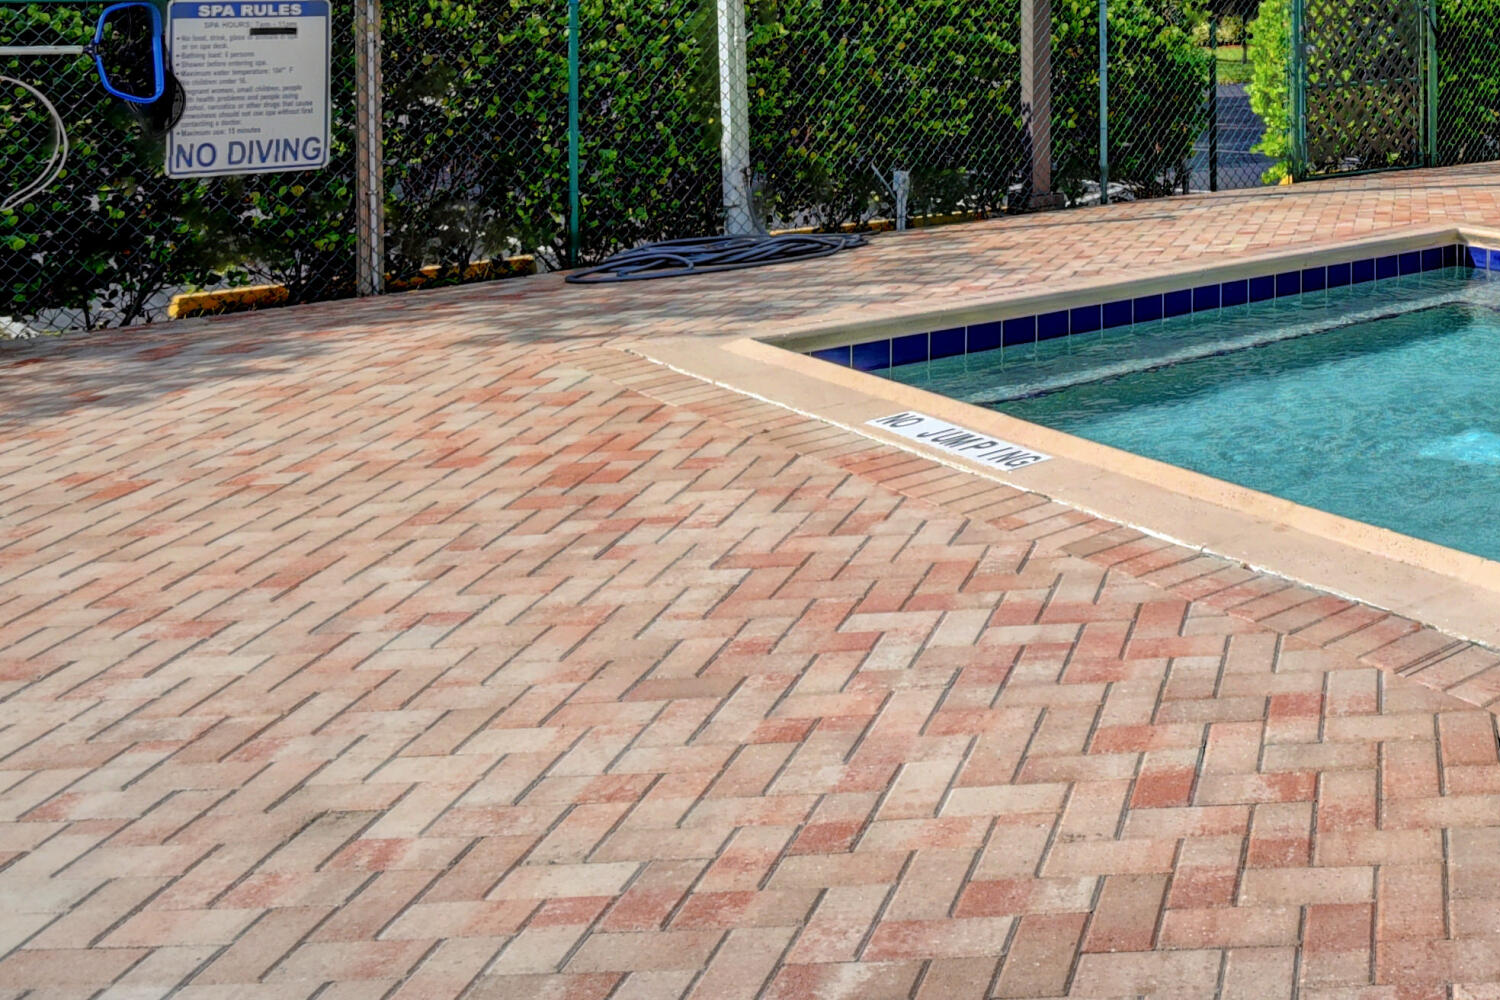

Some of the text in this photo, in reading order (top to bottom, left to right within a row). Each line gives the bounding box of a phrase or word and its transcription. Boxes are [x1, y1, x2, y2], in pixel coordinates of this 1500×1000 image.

[198, 3, 302, 17] SPA RULES
[181, 129, 211, 137] Maximum
[175, 136, 321, 168] NO DIVING
[875, 412, 1043, 468] NO JUMPING
